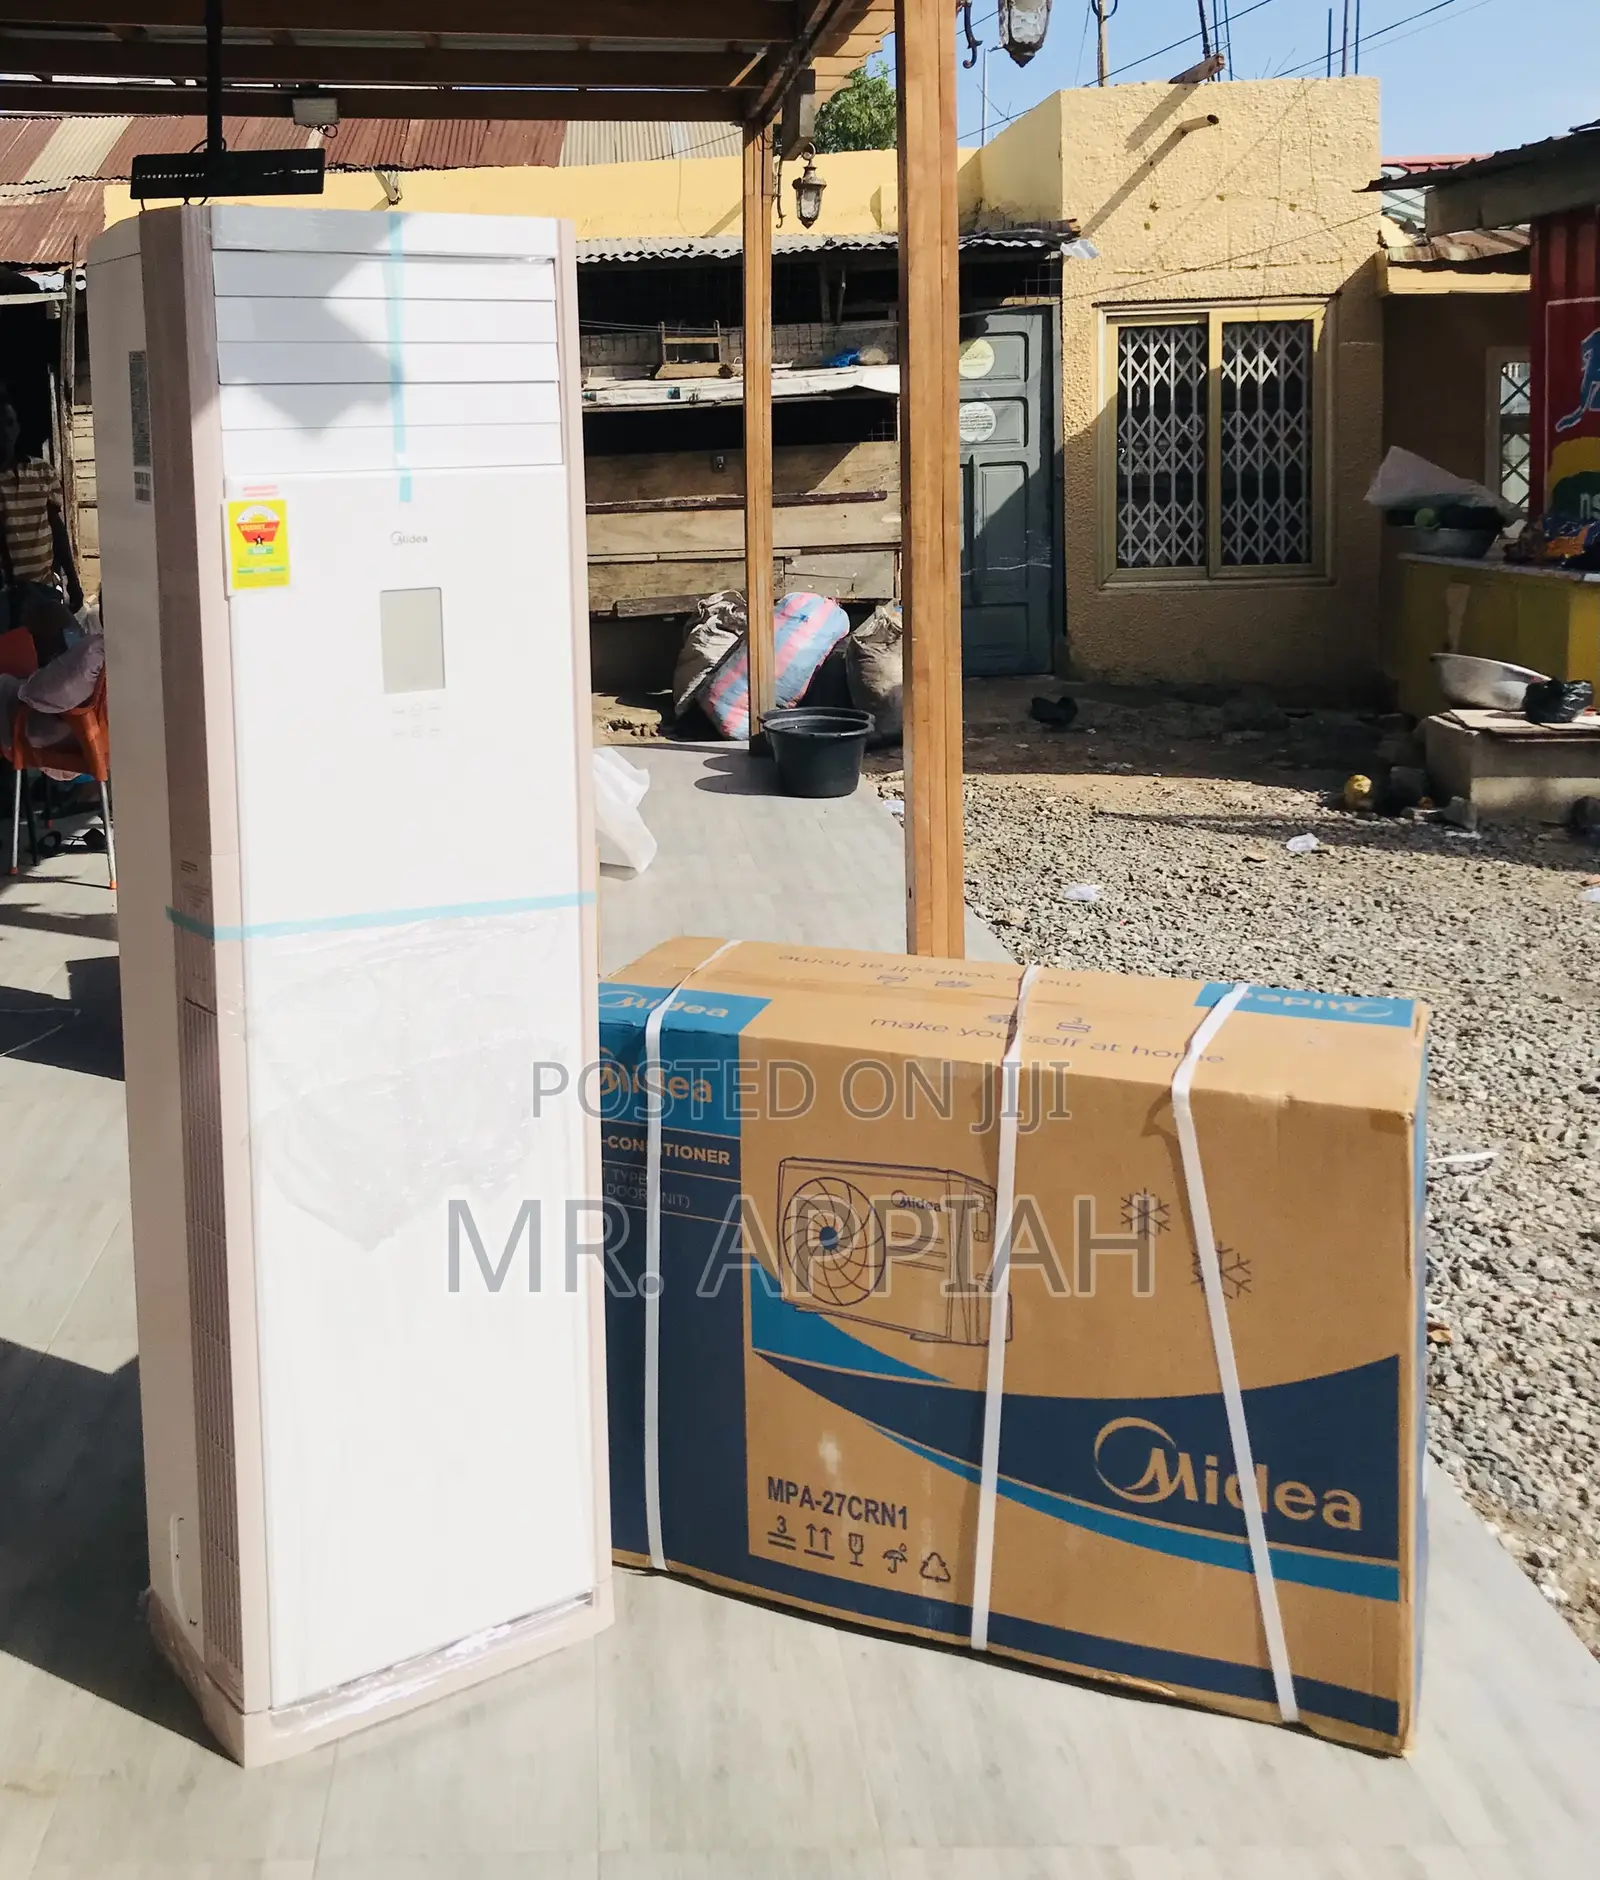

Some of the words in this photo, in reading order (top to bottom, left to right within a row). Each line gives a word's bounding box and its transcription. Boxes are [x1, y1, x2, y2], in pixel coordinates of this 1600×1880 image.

[391, 531, 428, 545] Midea
[778, 953, 850, 968] home
[858, 962, 883, 971] at
[892, 964, 995, 981] yourself
[599, 990, 728, 1018] Midea
[870, 1017, 949, 1034] make
[956, 1026, 1082, 1049] youself
[1089, 1041, 1122, 1054] at
[891, 1189, 941, 1212] Midea
[1094, 1416, 1362, 1531] Midea
[767, 1476, 907, 1530] MPA-27CRN1
[777, 1515, 787, 1534] 3
